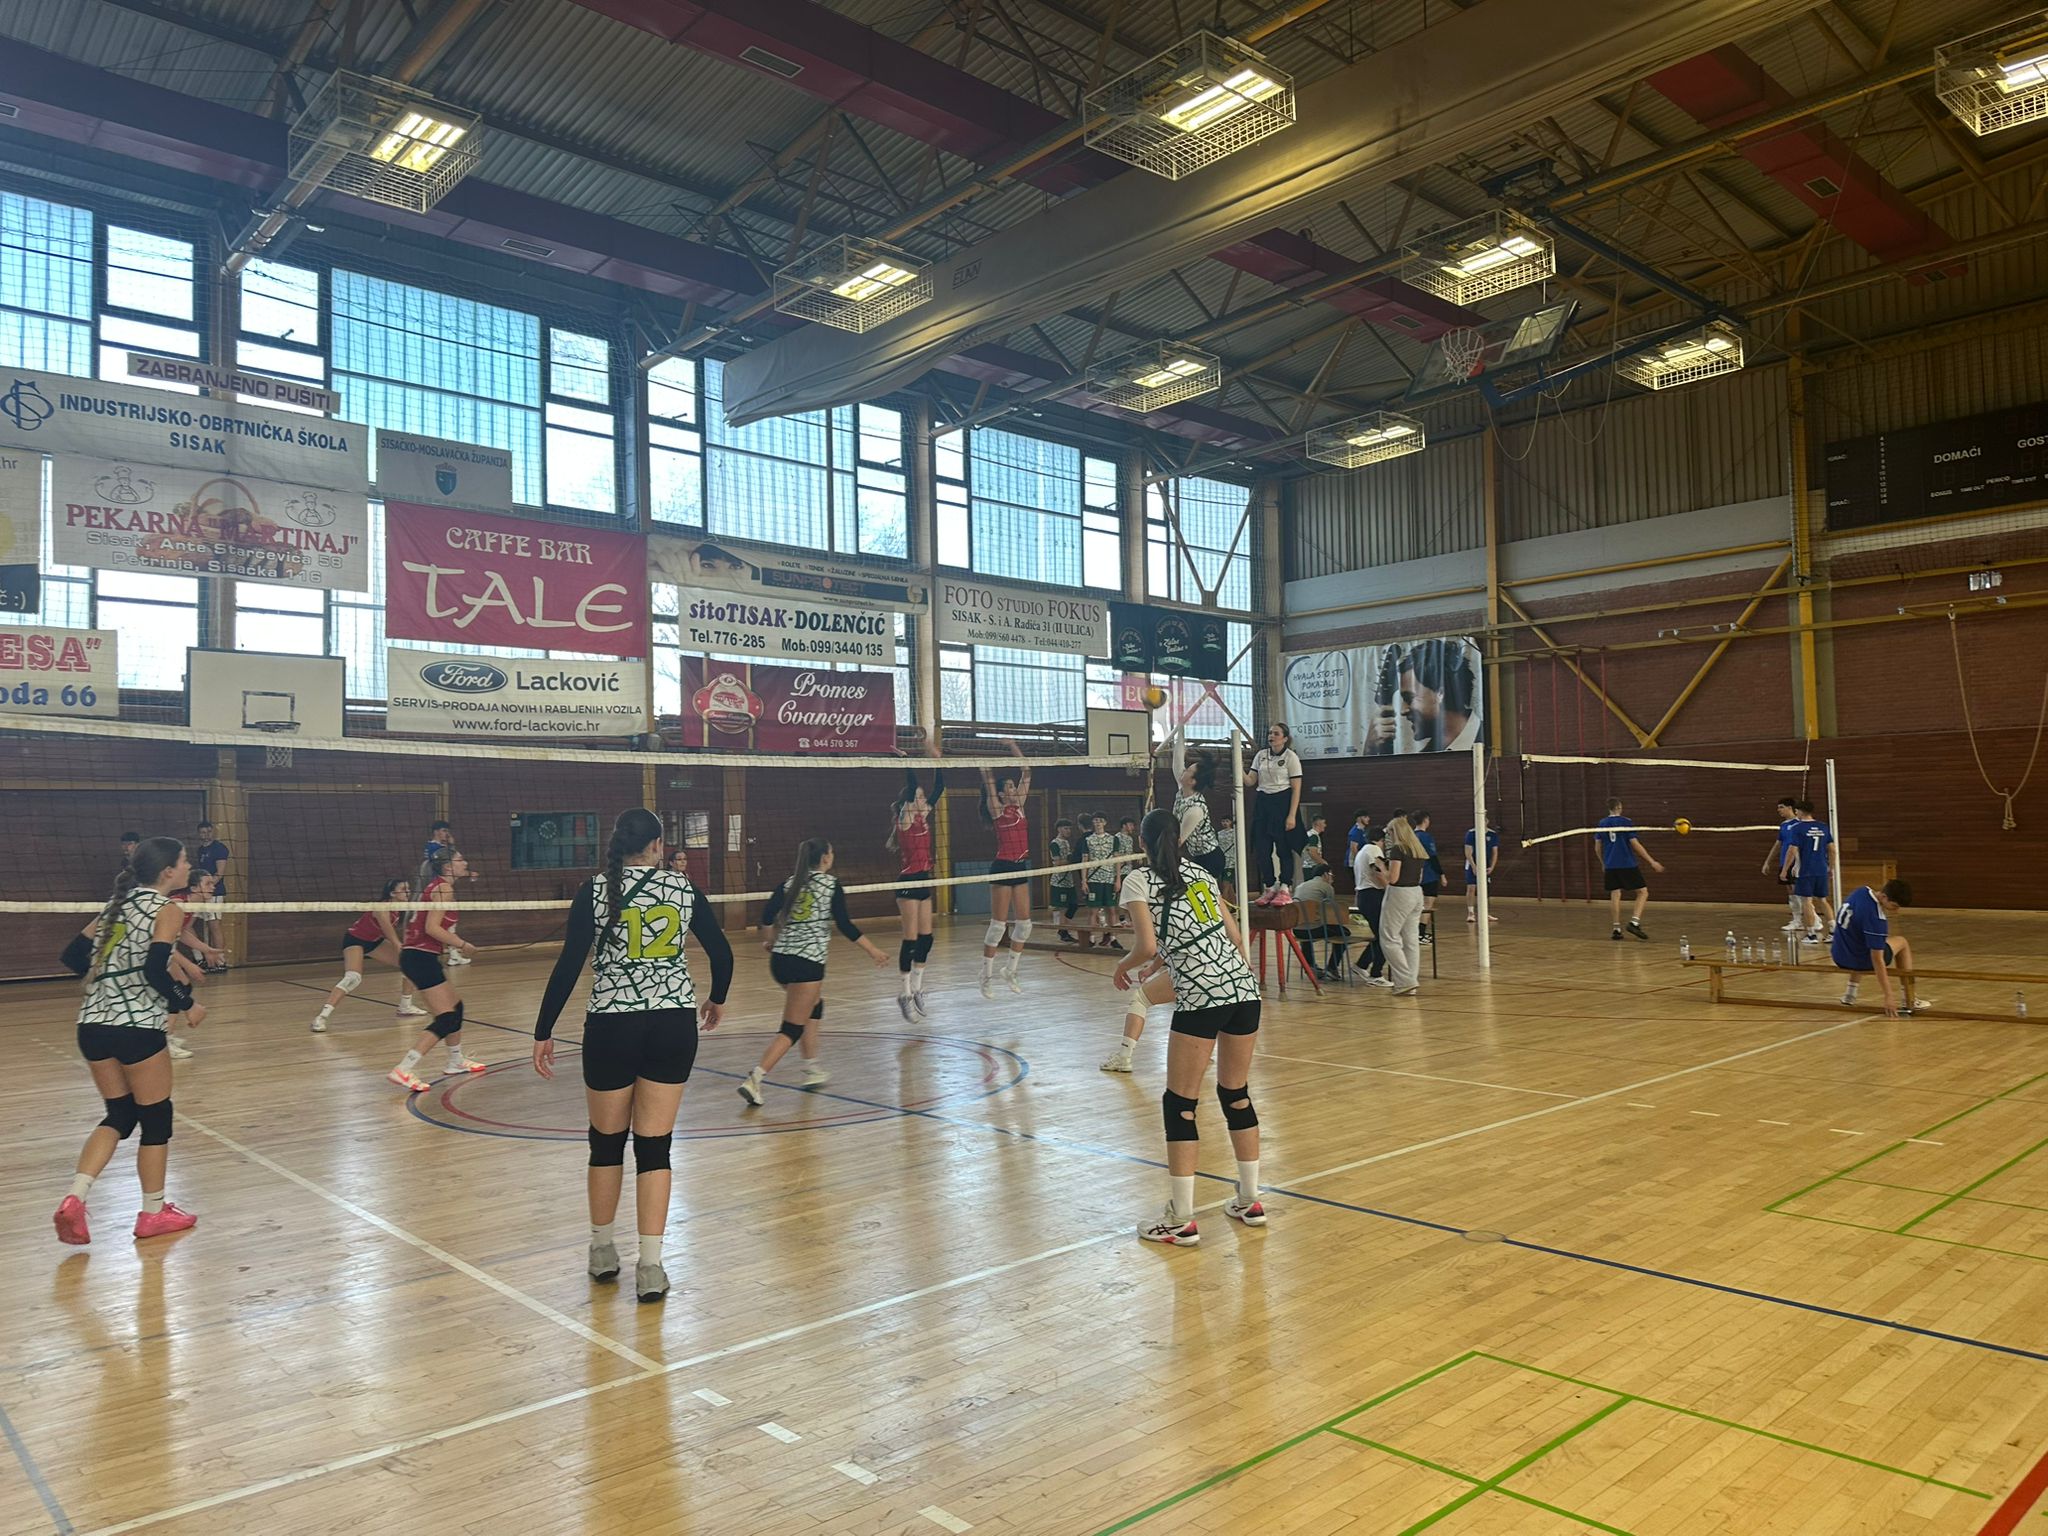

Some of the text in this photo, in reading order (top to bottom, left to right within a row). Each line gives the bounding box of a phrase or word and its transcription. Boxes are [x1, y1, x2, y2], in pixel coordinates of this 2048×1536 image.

[136, 358, 331, 410] ZABRANJENO PUŠITI
[60, 393, 348, 452] INDUSTRIJSKO-OBRTNIČKA ŠKOLA
[169, 431, 226, 454] SISAK
[380, 437, 470, 461] SISAČKO-MOSLAVAČKA
[65, 503, 205, 538] PEKARNA
[86, 530, 150, 550] Sisak,
[160, 537, 207, 553] Ante
[446, 526, 593, 565] CAFFE BAR
[112, 551, 200, 573] Petrinja,
[401, 560, 633, 633] TALE
[944, 585, 1100, 623] FOTO STUDIO FOKUS
[689, 599, 885, 635] sitoTISAK-DOLENČIĆ
[952, 609, 982, 624] SISAK
[988, 615, 997, 626] S.
[1003, 617, 1013, 628] A.
[1062, 623, 1094, 638] ULICA)
[866, 643, 883, 657] 135
[437, 662, 620, 692] Ford Lacković
[790, 672, 867, 699] Promes
[61, 684, 97, 707] 66
[393, 697, 642, 715] SERVIS-PRODAJA NOVIH I RABLJENIH VOZILA
[452, 718, 600, 732] www.ford-lackovic.hr
[1297, 723, 1337, 735] GIBONNI
[1186, 880, 1219, 924] 11
[619, 904, 680, 959] 12
